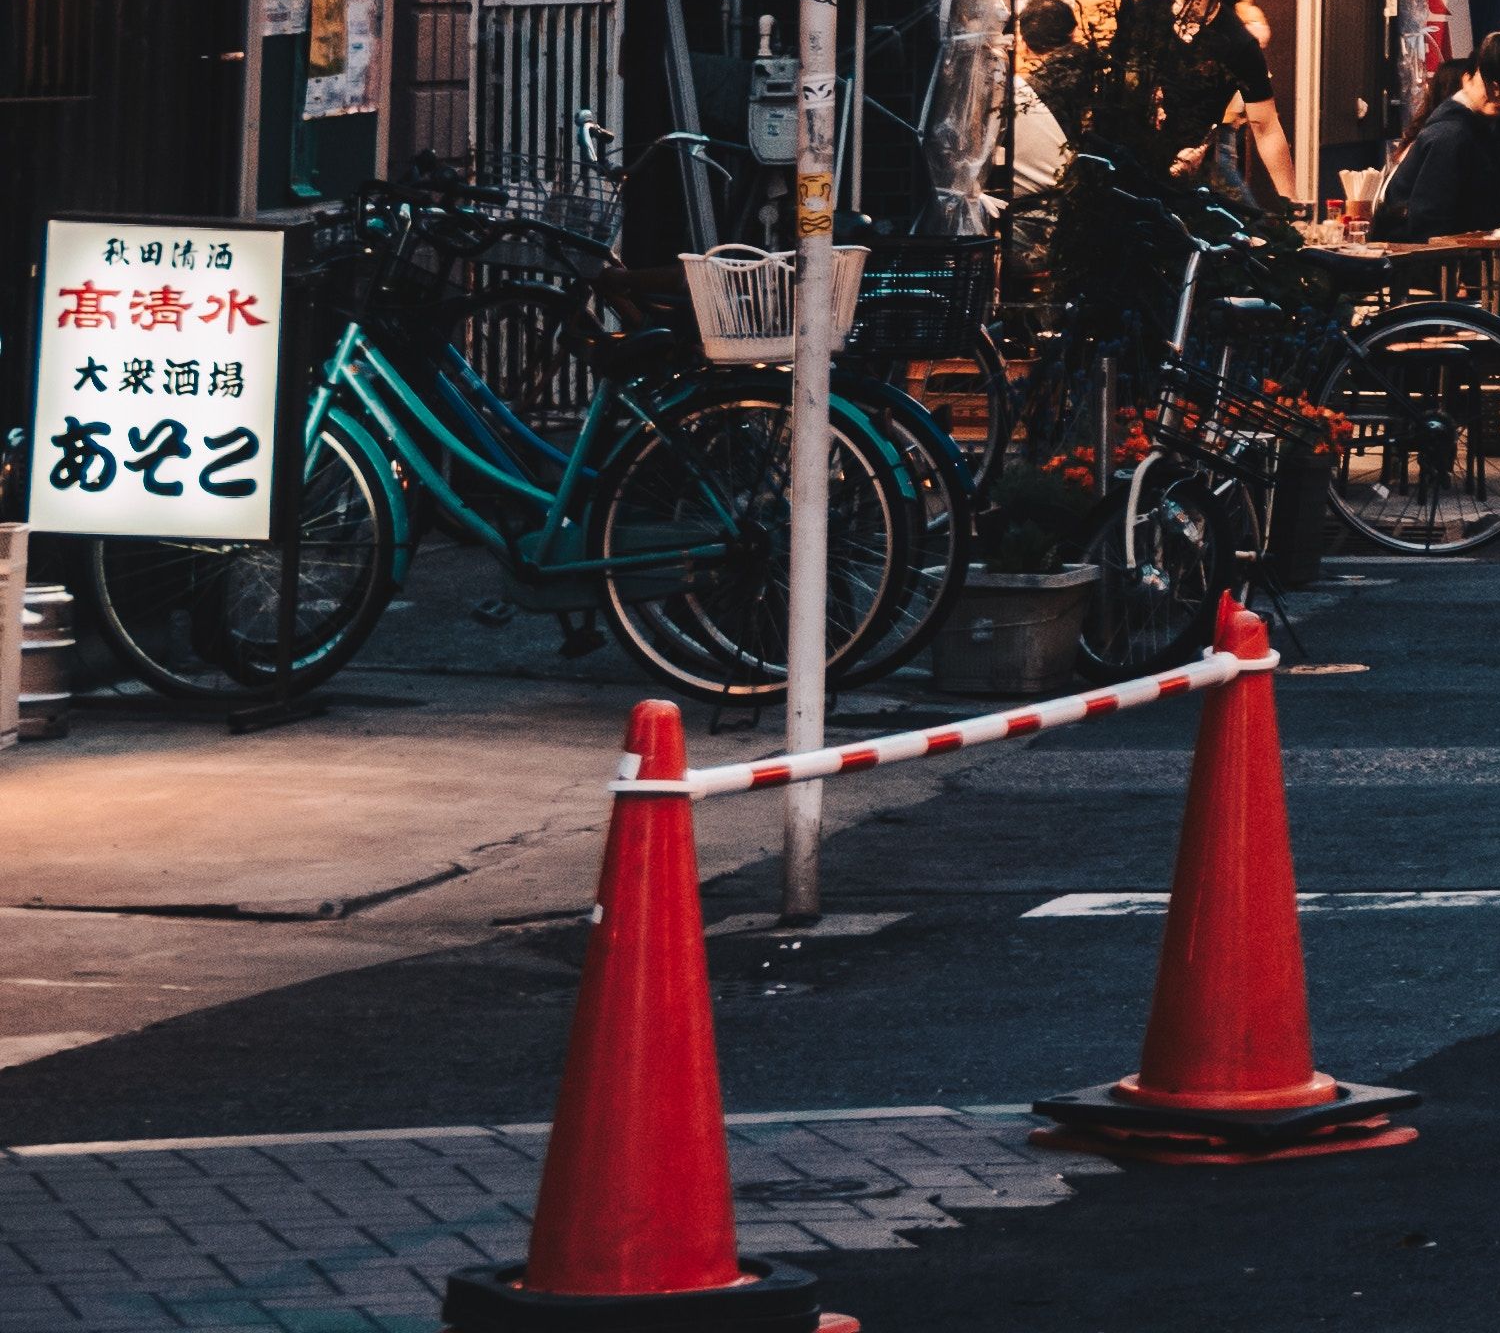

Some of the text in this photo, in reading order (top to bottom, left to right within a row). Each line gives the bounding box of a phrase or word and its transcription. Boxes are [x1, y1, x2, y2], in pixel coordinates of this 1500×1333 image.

[103, 237, 233, 270] 秋田清酒
[73, 355, 244, 399] 大衆酒場
[50, 415, 260, 498] あそこ
